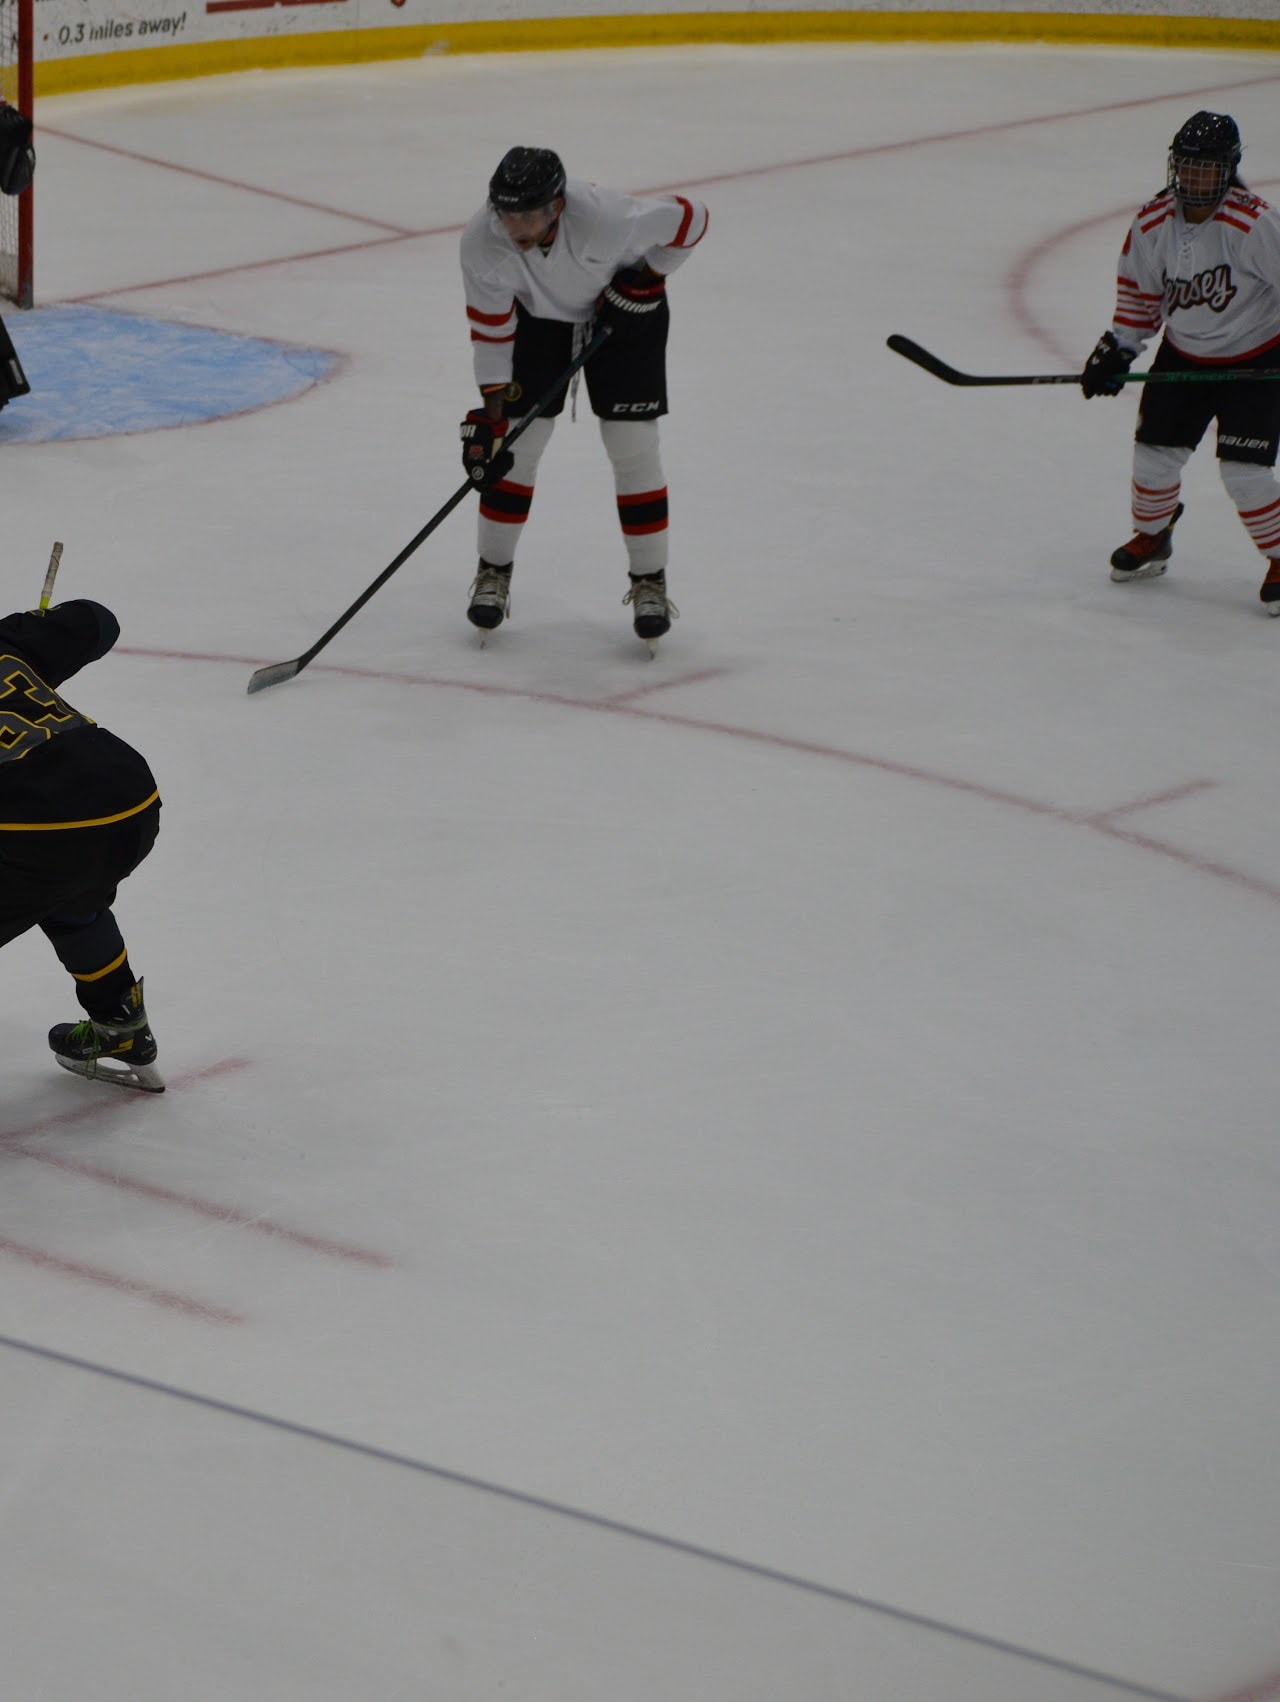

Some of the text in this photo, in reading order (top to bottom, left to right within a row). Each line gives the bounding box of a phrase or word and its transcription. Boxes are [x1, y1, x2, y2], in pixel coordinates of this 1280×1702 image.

[58, 11, 187, 45] 0.3 miles away!
[612, 400, 660, 413] CCM
[1218, 433, 1270, 450] BAUER
